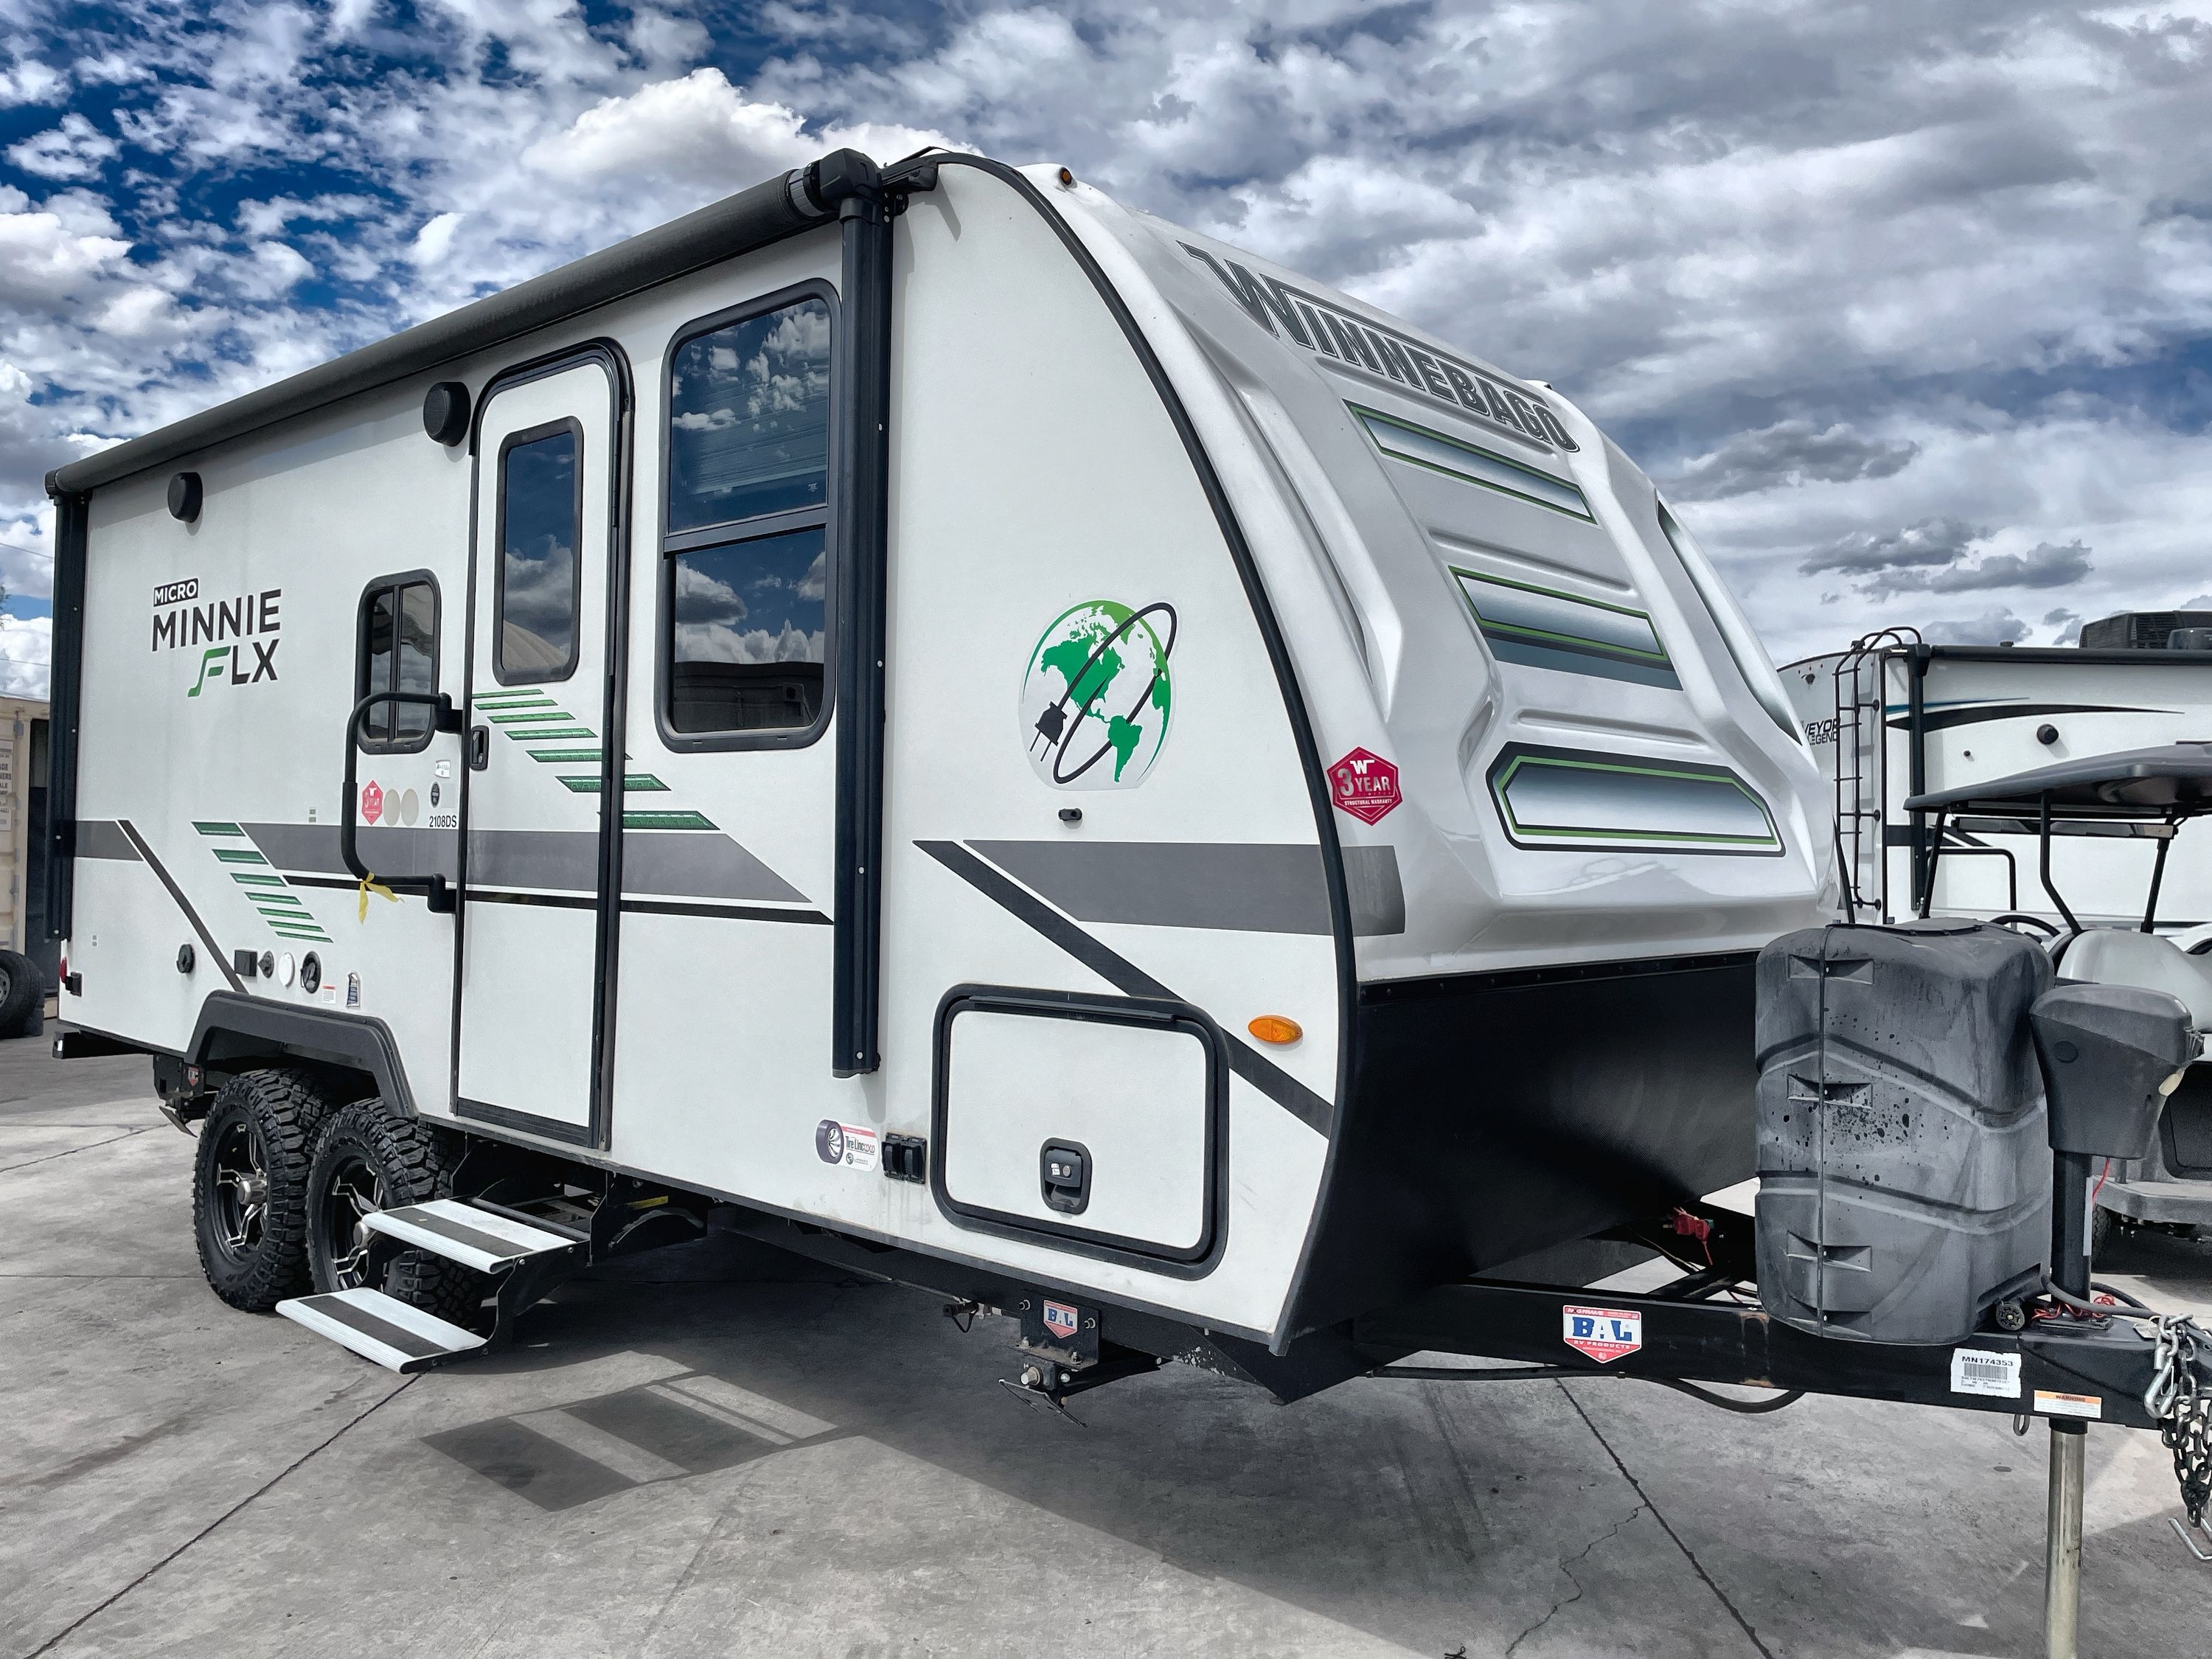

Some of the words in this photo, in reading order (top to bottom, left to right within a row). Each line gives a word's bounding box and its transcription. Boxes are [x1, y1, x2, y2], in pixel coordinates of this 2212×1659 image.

[1176, 240, 1580, 453] WINNEBAGO
[154, 581, 197, 605] MICRO
[152, 588, 282, 652] MINNIE
[187, 638, 280, 698] FLX
[1338, 768, 1354, 796] 3
[1354, 776, 1391, 792] YEAR
[429, 814, 457, 828] 2108DS
[1587, 1341, 1630, 1349] PRODUCTS
[1961, 1356, 2014, 1366] MN174353
[2056, 1394, 2086, 1402] WARNING
